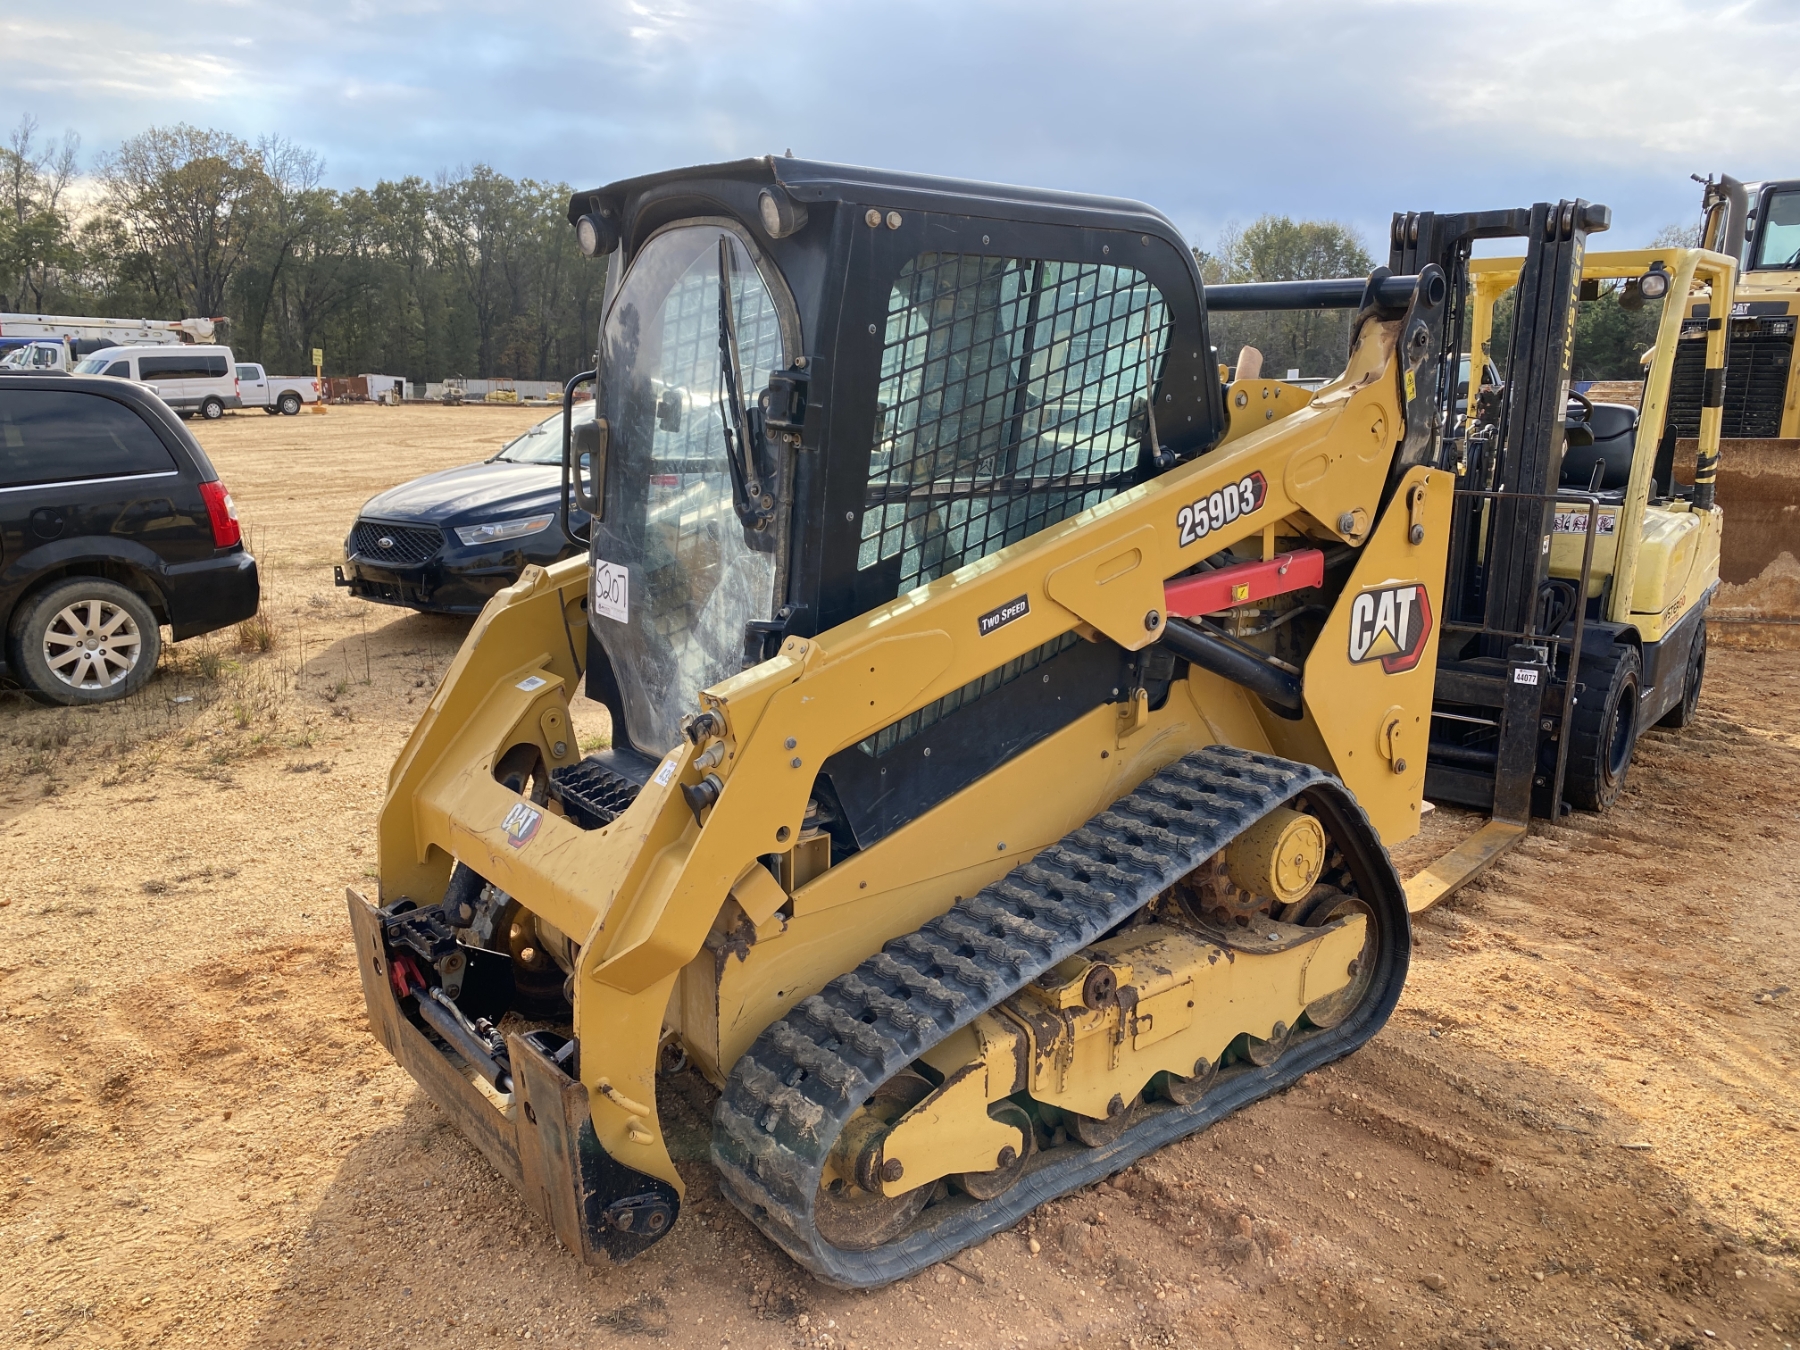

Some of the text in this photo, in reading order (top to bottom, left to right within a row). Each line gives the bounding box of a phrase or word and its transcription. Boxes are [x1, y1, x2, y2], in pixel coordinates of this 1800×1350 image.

[1563, 244, 1583, 371] HYSTER
[1177, 477, 1256, 547] 259D3
[596, 563, 627, 608] 5207
[1349, 586, 1417, 663] CAT
[1516, 673, 1537, 683] 44077
[502, 803, 540, 838] CAT
